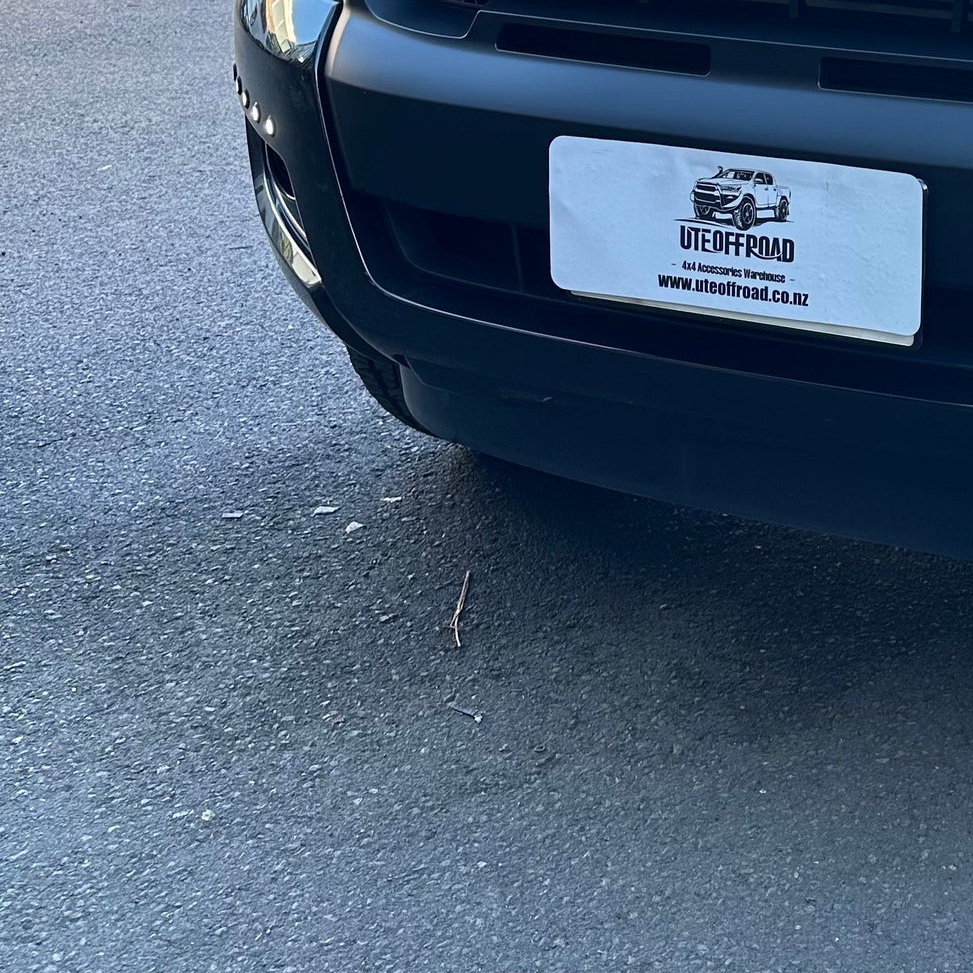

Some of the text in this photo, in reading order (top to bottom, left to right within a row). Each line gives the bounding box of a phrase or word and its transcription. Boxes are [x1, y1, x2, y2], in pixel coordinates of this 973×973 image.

[682, 260, 786, 283] 4x4 Accessories Warehouse
[658, 274, 809, 306] www.uteoffroad.co.nz
